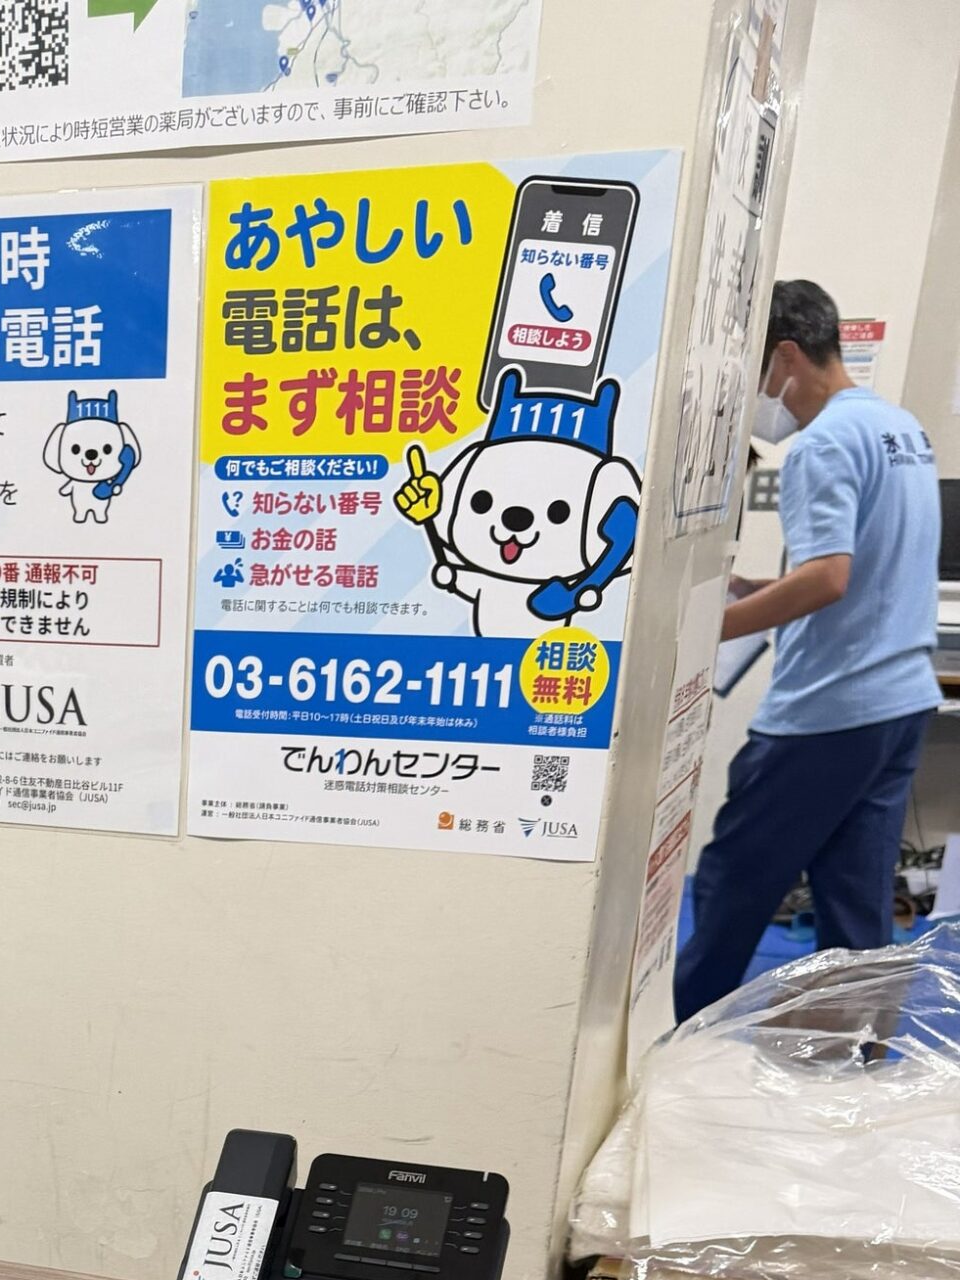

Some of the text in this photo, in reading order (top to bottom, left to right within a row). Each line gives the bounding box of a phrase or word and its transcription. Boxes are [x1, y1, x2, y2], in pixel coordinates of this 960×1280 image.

[224, 197, 472, 271] あやしい
[520, 247, 610, 270] 知らない番号
[222, 285, 422, 355] 電話は、
[511, 327, 585, 349] 相談しよう
[76, 402, 110, 417] 1111
[220, 365, 462, 436] まず相談
[509, 401, 587, 438] 1111
[252, 490, 382, 516] 知らない番号
[250, 527, 337, 552] お金の話
[24, 563, 99, 585] 通報不可
[248, 562, 379, 588] 急がせる電話
[220, 599, 429, 617] 電話に関することは何でも相談できます。
[535, 640, 598, 673] 相談
[204, 655, 514, 709] 03-6162-1111
[532, 674, 592, 706] 無料
[323, 779, 449, 797] 迷惑電話対策相談センター
[8, 800, 57, 813] sec@jusa.jp
[459, 818, 507, 835] 総務省
[541, 821, 578, 837] JUSA
[387, 1170, 427, 1184] Fanvil
[204, 1202, 245, 1271] JUSA
